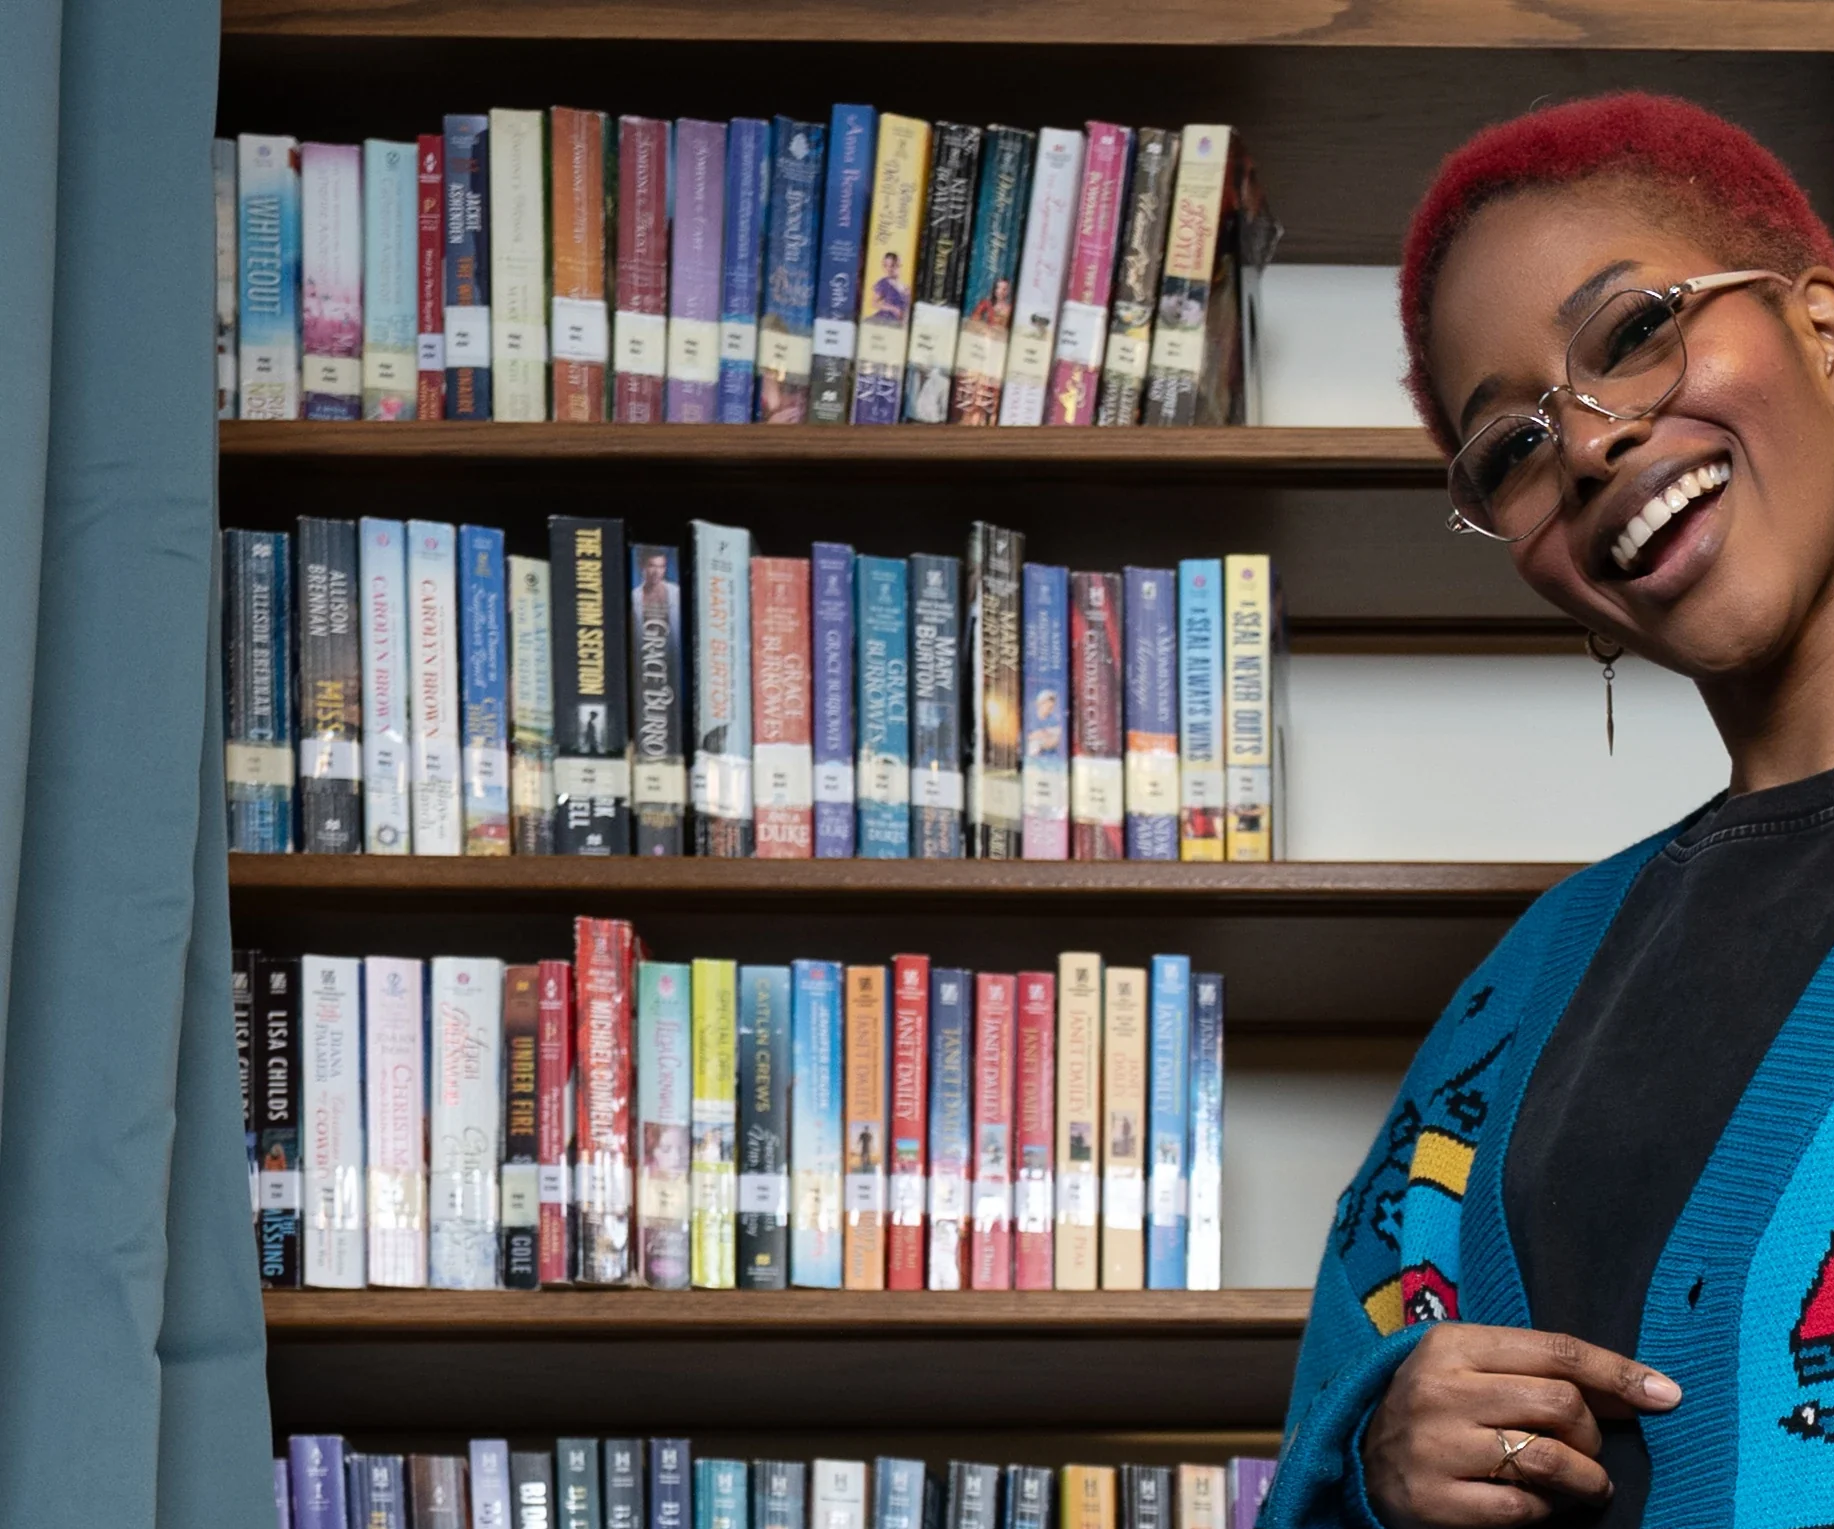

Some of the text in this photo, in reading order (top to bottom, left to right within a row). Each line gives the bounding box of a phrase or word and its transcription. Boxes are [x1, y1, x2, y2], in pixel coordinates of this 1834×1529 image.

[246, 197, 282, 316] WHITEOUT
[307, 563, 328, 637] BRENNAN
[329, 571, 347, 634] ALLISON
[575, 527, 603, 695] THE RHYTHM SECTION
[915, 624, 937, 698] BURTON
[936, 636, 956, 690] MARY
[1185, 617, 1212, 762] SEAL ALWAYS WINS
[1234, 611, 1263, 755] SEAL NEVER QUITS
[267, 1010, 289, 1121] LISA CHILDS
[512, 1036, 534, 1136] UNDER FIRE
[590, 1000, 613, 1146] MICHAEL CONNELLY
[896, 1009, 916, 1122] JANET DAILEY
[512, 1236, 532, 1273] COLE
